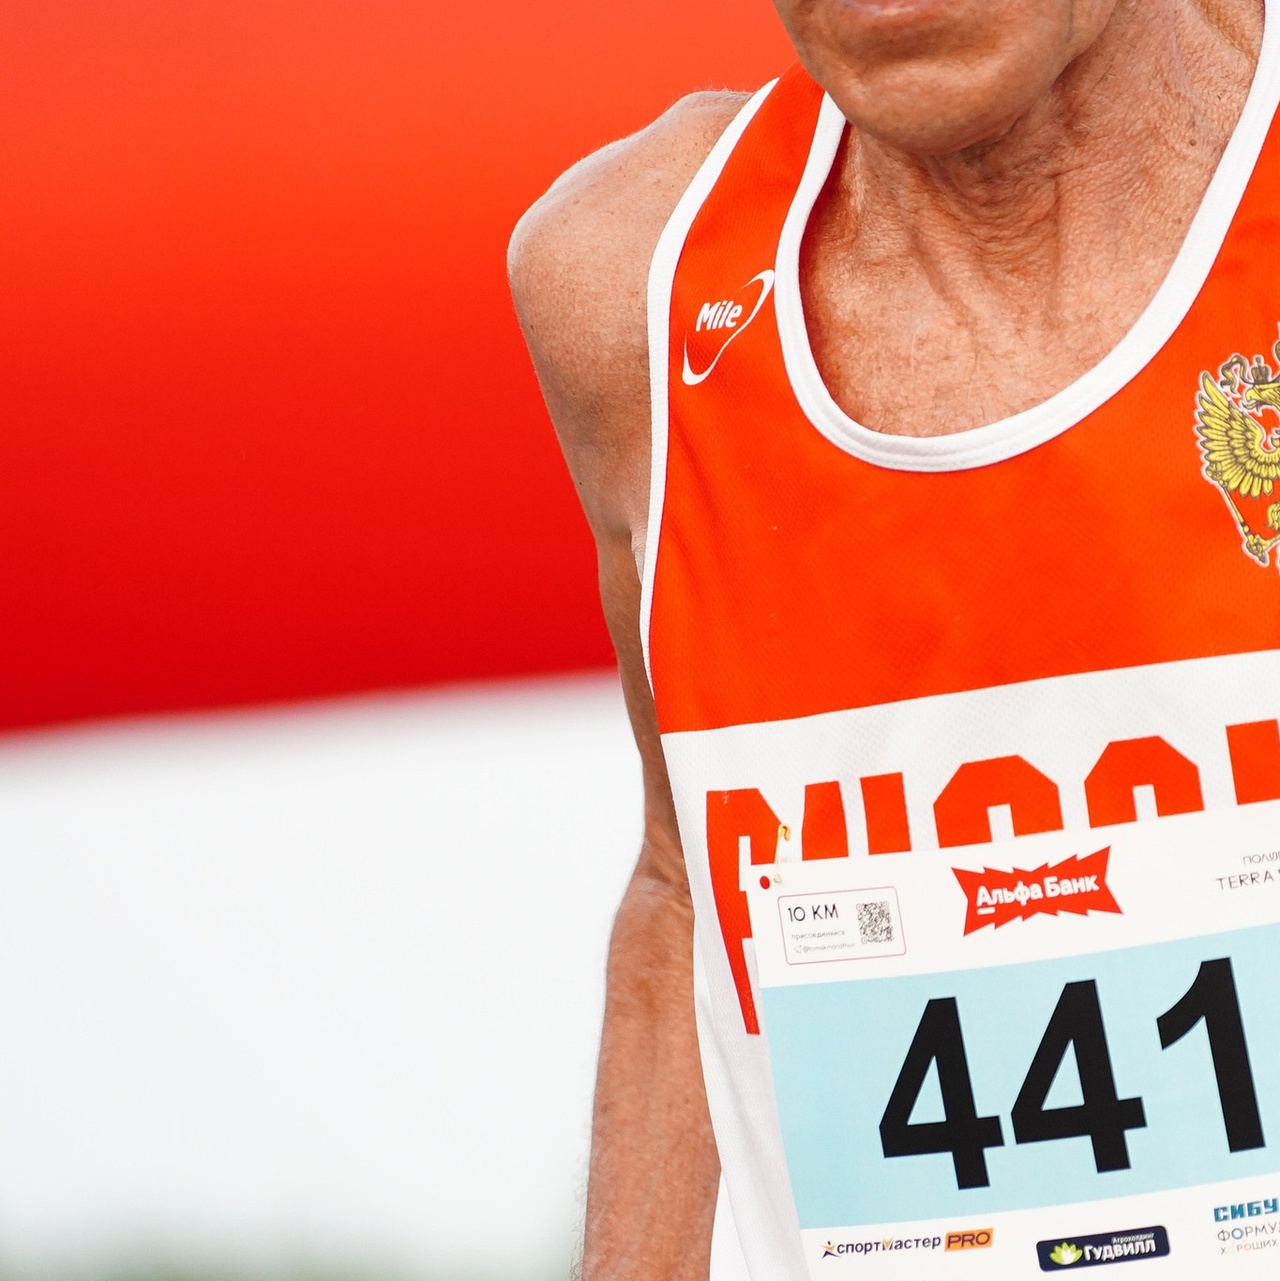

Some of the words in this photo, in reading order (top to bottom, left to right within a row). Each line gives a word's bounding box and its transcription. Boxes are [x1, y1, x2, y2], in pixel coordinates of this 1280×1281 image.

[695, 300, 743, 332] Mile
[1216, 870, 1274, 890] TERRA
[976, 881, 1043, 910] Альфа
[1043, 875, 1100, 898] Банк
[788, 906, 806, 922] 10
[879, 956, 1266, 1190] 441
[947, 1231, 991, 1249] PRO
[1220, 1237, 1278, 1255] ХРОШИХ
